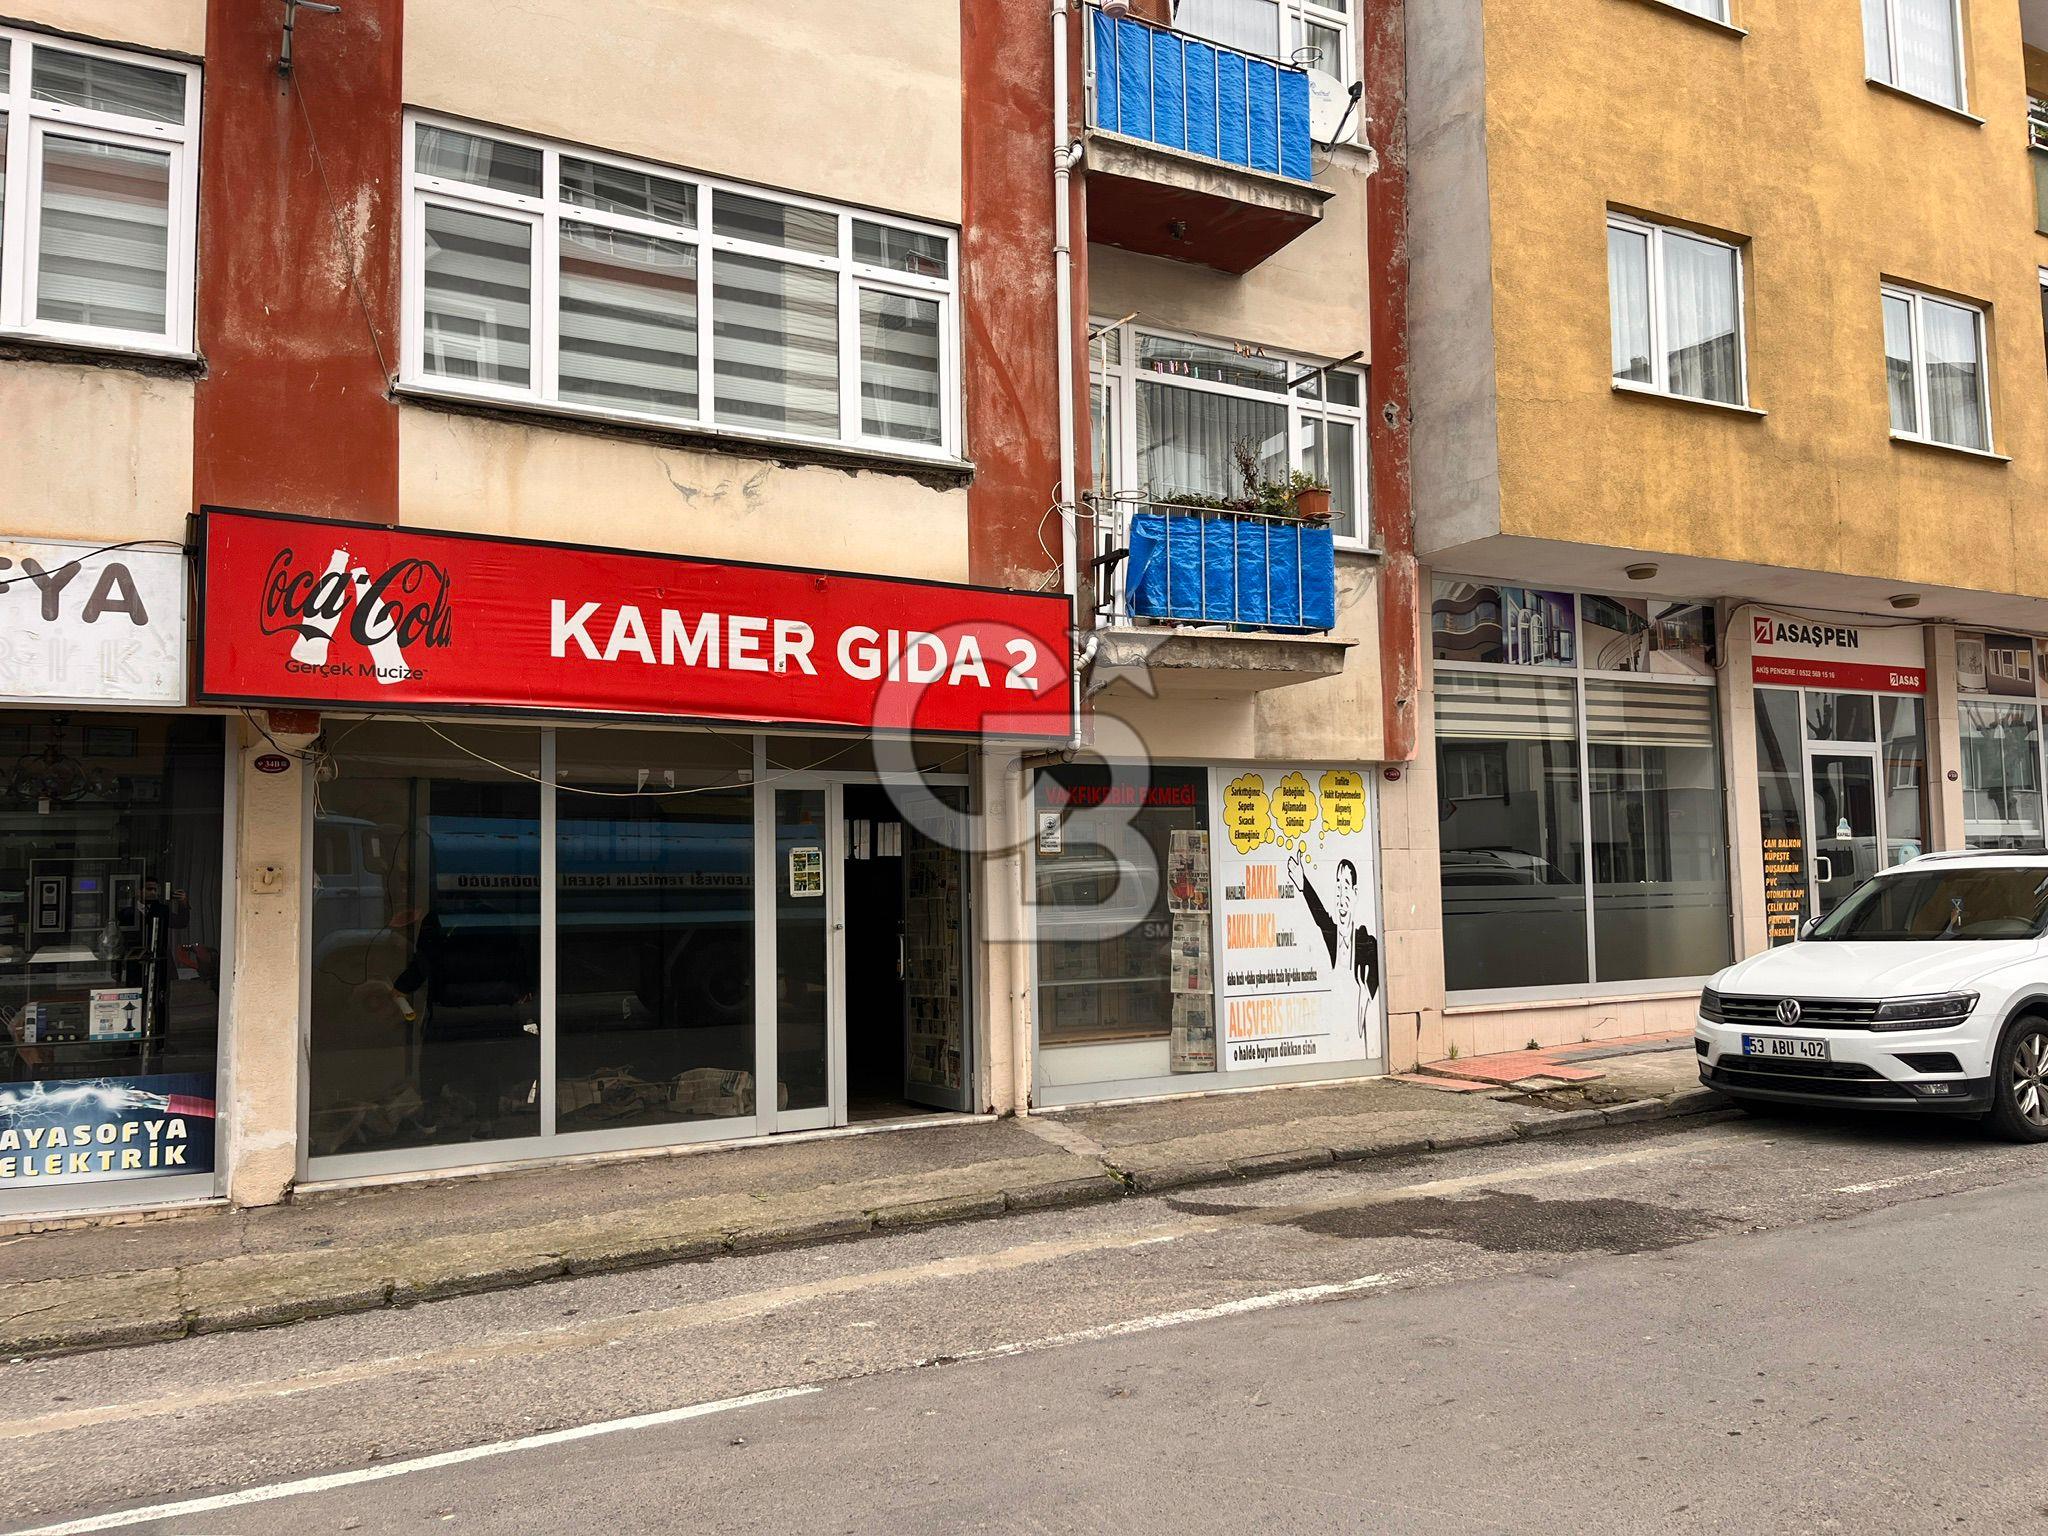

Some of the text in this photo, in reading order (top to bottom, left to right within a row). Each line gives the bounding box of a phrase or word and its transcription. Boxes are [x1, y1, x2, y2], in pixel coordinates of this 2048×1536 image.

[1775, 623, 1859, 648] ASAŞPEN
[550, 599, 1039, 691] KAMER GIDA 2
[284, 660, 424, 681] Gerçek Mucize
[1769, 667, 1796, 676] PENCERE
[1898, 674, 1920, 687] ASAŞ
[1045, 783, 1197, 805] VAKFIKEBİR EKMEĞİ
[1238, 801, 1255, 813] Sepete
[1238, 815, 1255, 825] Sıcacık
[1234, 830, 1260, 842] Ekmeğiniz
[1763, 838, 1802, 848] CAM BALKON
[1764, 850, 1790, 862] KÜPEŞTE
[1765, 863, 1799, 875] DUŞAKABİN
[1765, 877, 1778, 887] PVC
[1766, 888, 1805, 899] OTOMATİK KAPI
[1767, 902, 1799, 914] ÇELİK KAPI
[1227, 913, 1255, 949] BAKKAL
[1233, 1049, 1238, 1061] o
[1238, 1045, 1256, 1061] halde
[1256, 1044, 1279, 1063] buyrun
[1279, 1041, 1302, 1057] dükkan
[1302, 1039, 1317, 1055] sizin
[1750, 1038, 1825, 1058] 53 ABU 402
[0, 1118, 188, 1151] AYASOFYA
[0, 1143, 188, 1178] ELEKTRİK
